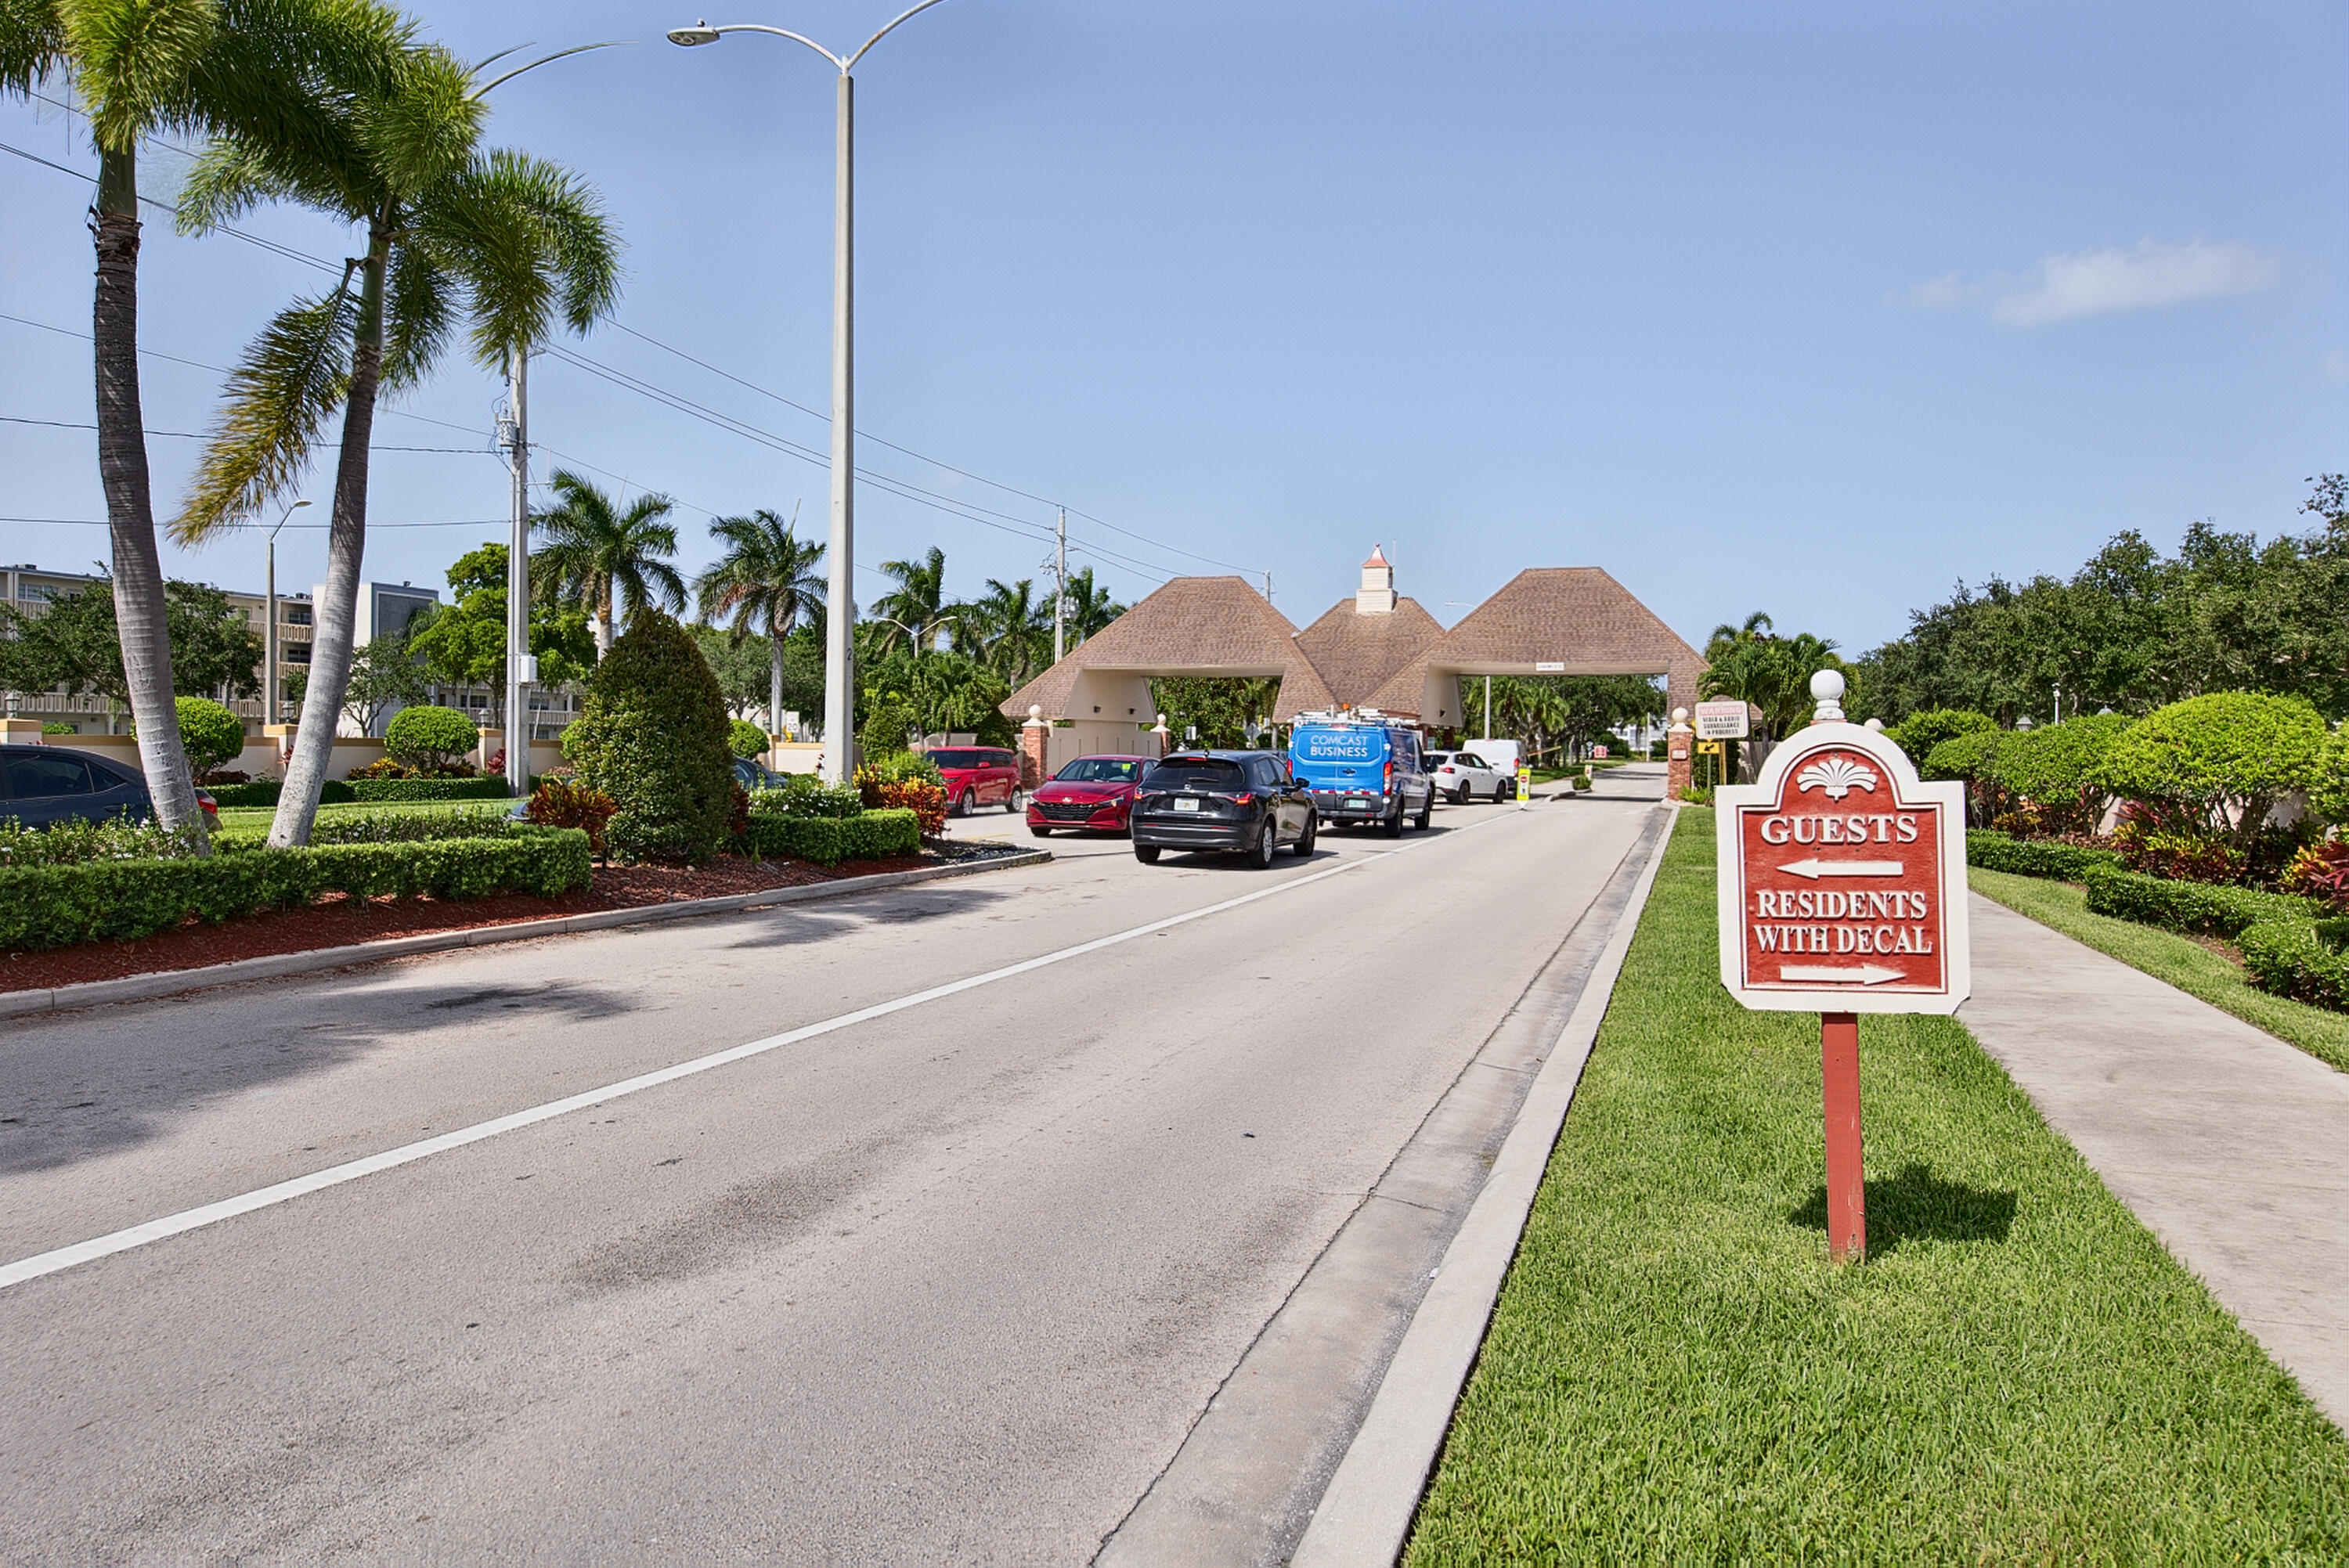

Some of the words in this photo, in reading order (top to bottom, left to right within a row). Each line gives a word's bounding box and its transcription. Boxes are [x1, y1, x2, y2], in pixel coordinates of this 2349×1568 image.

[847, 647, 853, 661] 2
[1310, 735, 1369, 746] COMCAST
[1310, 746, 1369, 757] BUSINESS
[1761, 815, 1918, 845] GUESTS
[1755, 890, 1928, 920] RESIDENTS
[1753, 925, 1830, 953] WITH
[1835, 925, 1933, 955] DECAL
